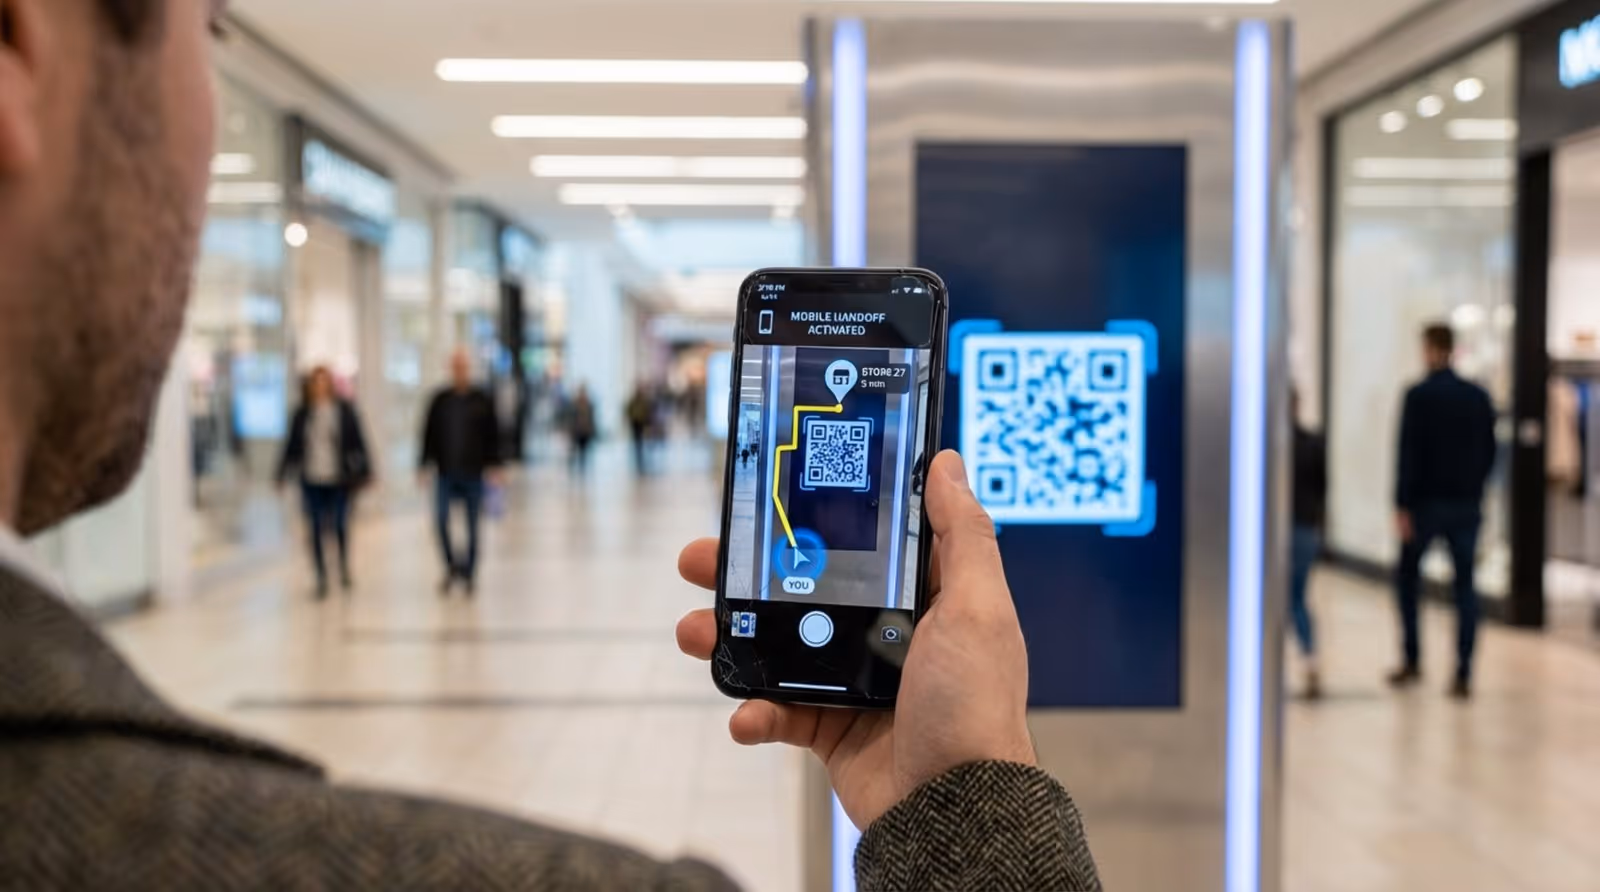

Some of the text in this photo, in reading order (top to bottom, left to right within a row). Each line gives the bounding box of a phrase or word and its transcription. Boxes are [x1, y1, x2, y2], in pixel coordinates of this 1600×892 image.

[790, 311, 832, 322] MOBILE
[893, 368, 906, 377] 27
[788, 580, 810, 591] YOU
